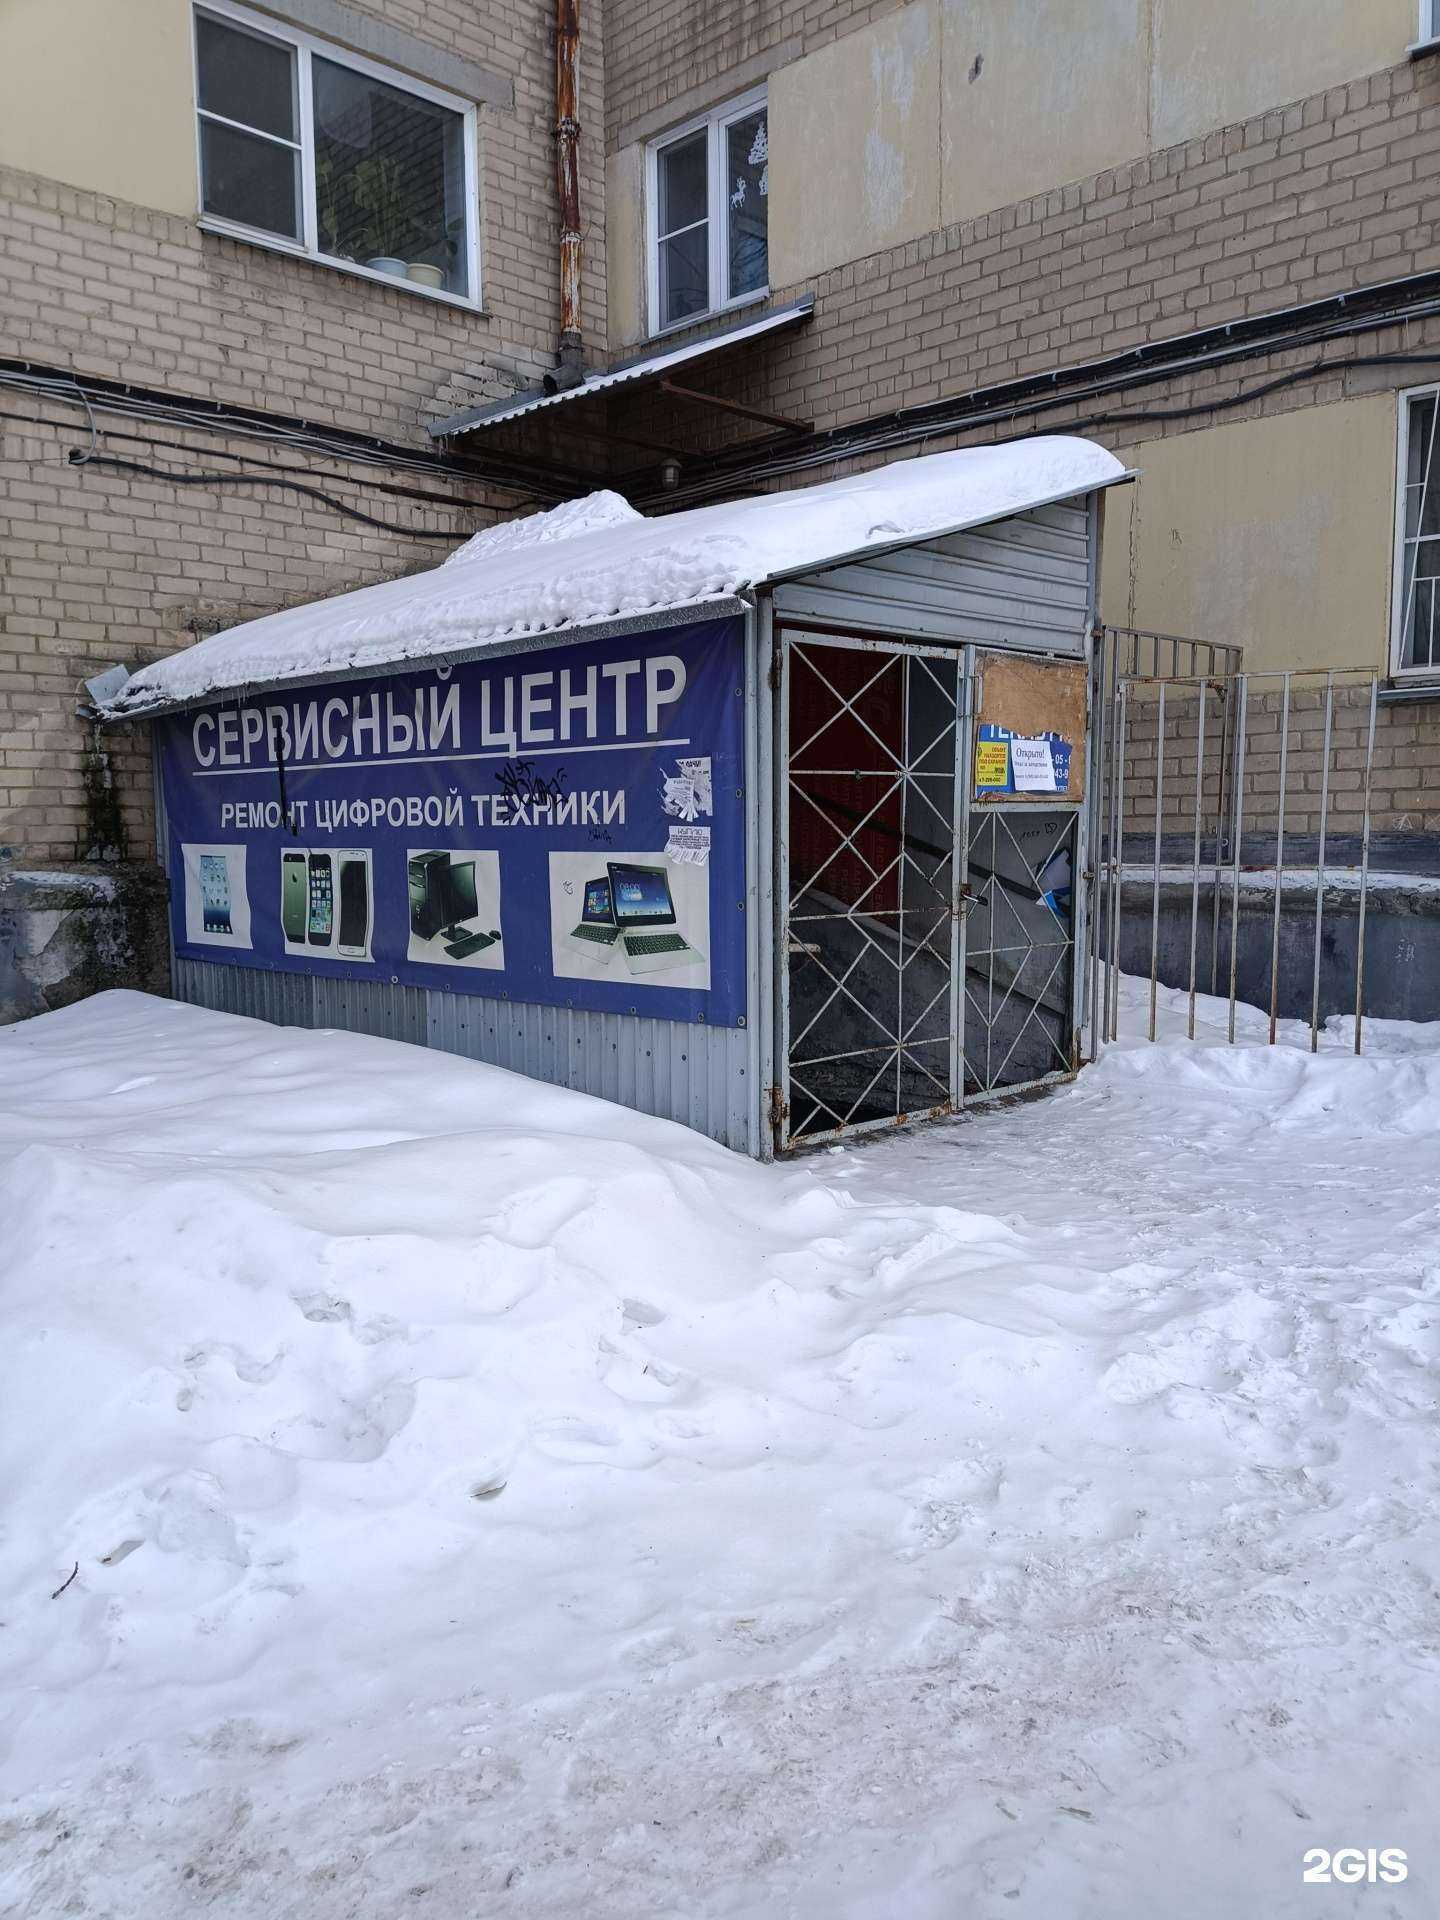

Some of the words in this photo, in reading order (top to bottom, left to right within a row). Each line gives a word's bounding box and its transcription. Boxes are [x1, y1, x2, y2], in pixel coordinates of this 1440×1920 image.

[193, 667, 461, 767] СЕРВИСНЫЙ
[481, 655, 687, 758] ЦЕНТР
[1016, 747, 1045, 760] Открыто!
[221, 800, 309, 829] РЕМОНТ
[315, 787, 464, 833] ЦИФРОВОЙ
[472, 789, 626, 827] ТЕХНИКИ
